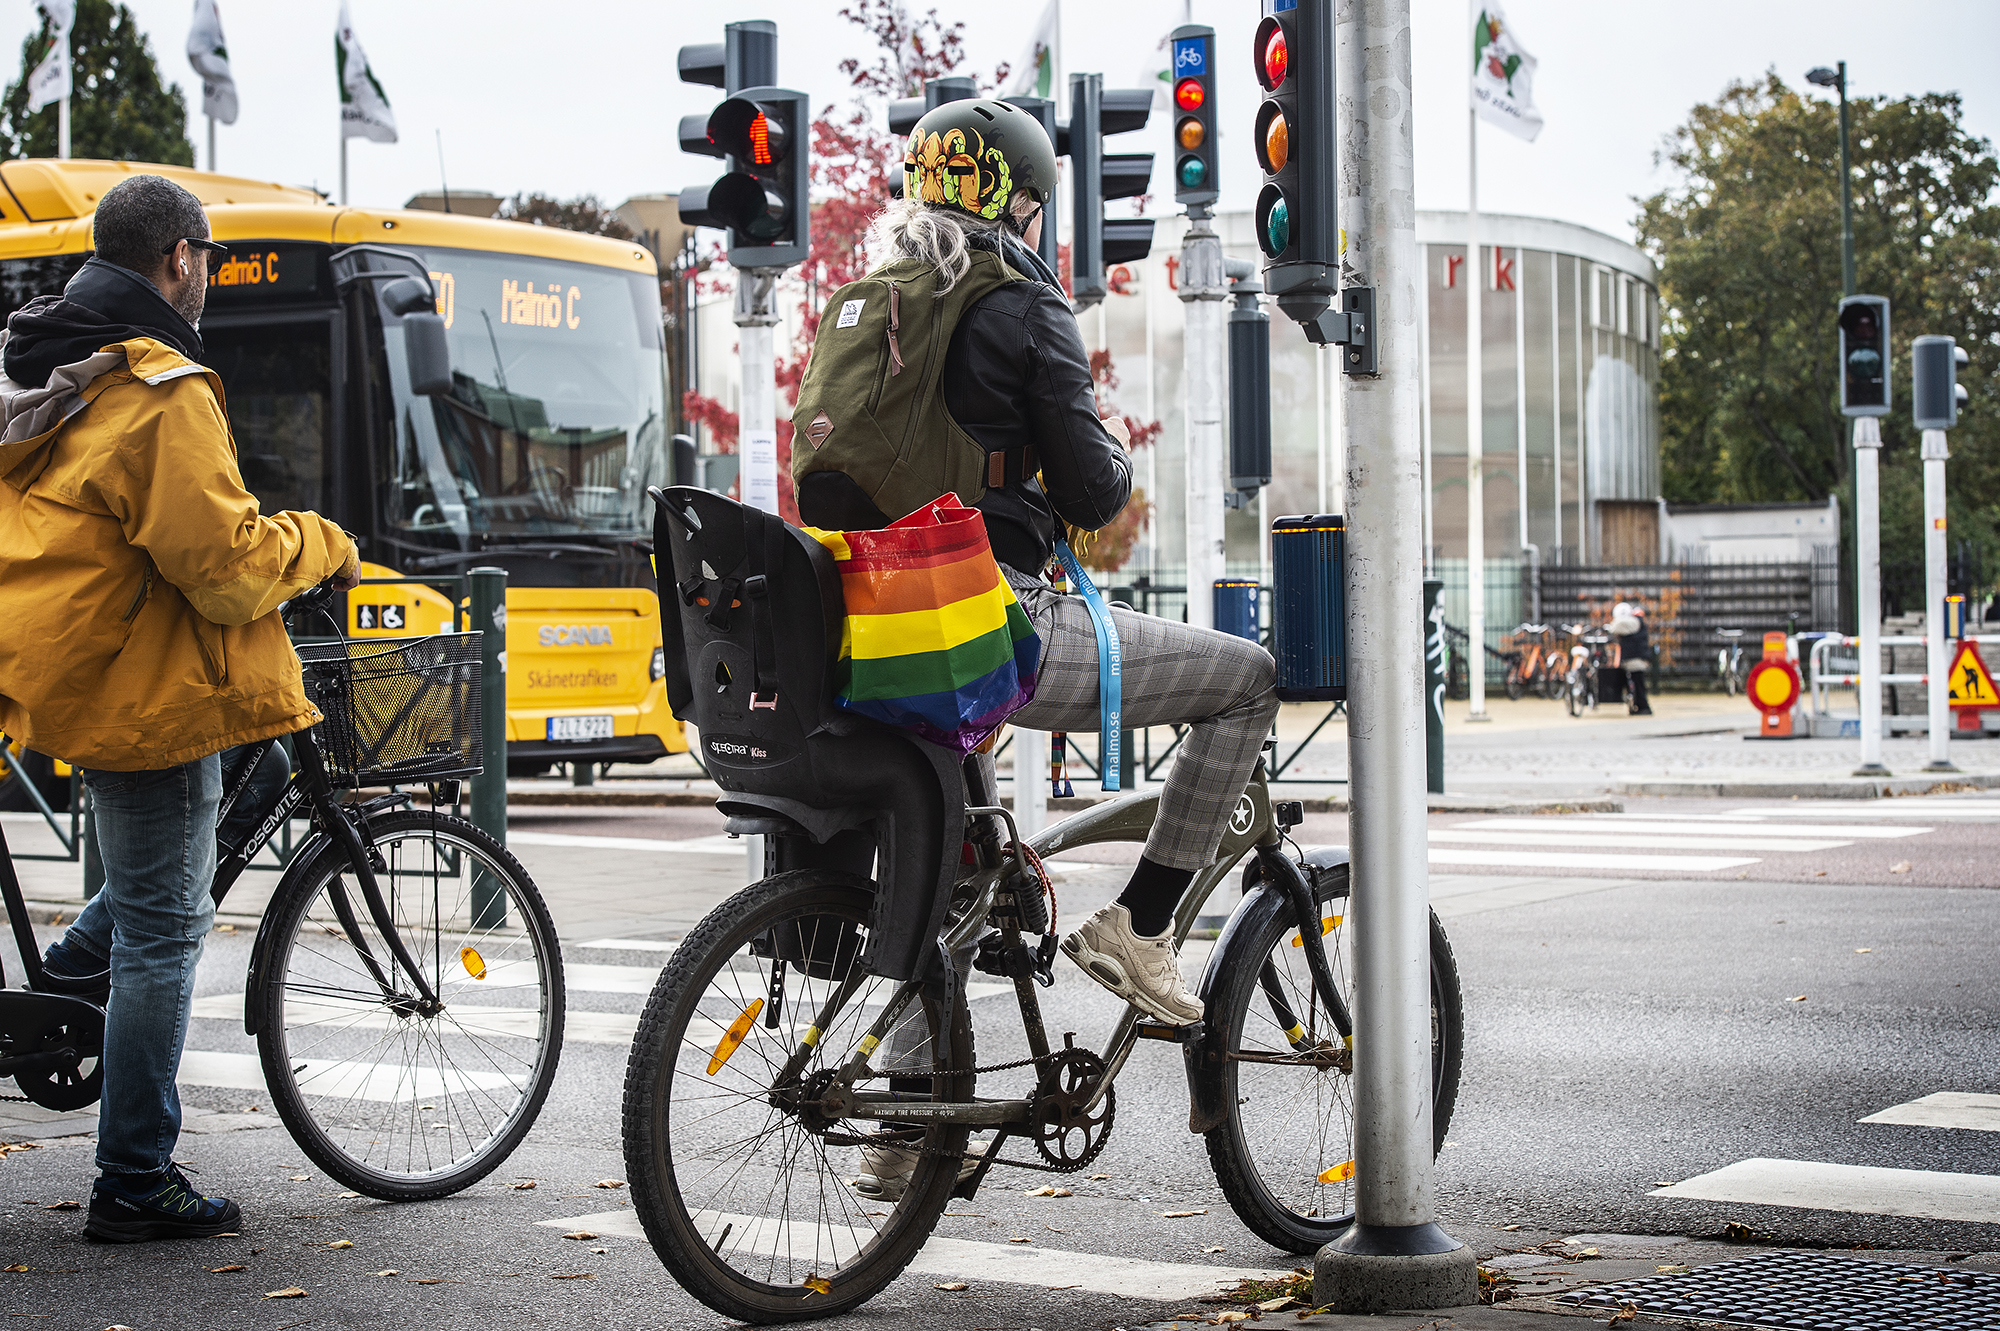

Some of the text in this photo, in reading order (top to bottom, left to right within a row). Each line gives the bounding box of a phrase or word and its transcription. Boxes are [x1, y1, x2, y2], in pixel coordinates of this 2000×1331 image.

[265, 251, 279, 283] C
[501, 278, 562, 329] Malmö
[566, 285, 581, 330] C
[538, 624, 613, 647] SCANIA
[1103, 615, 1120, 676] malmo.se
[527, 668, 618, 689] Skånetrafiken
[584, 717, 608, 736] 922
[751, 747, 767, 758] Kiss
[1107, 711, 1120, 777] malmo.se
[237, 784, 301, 862] YOSEMITE
